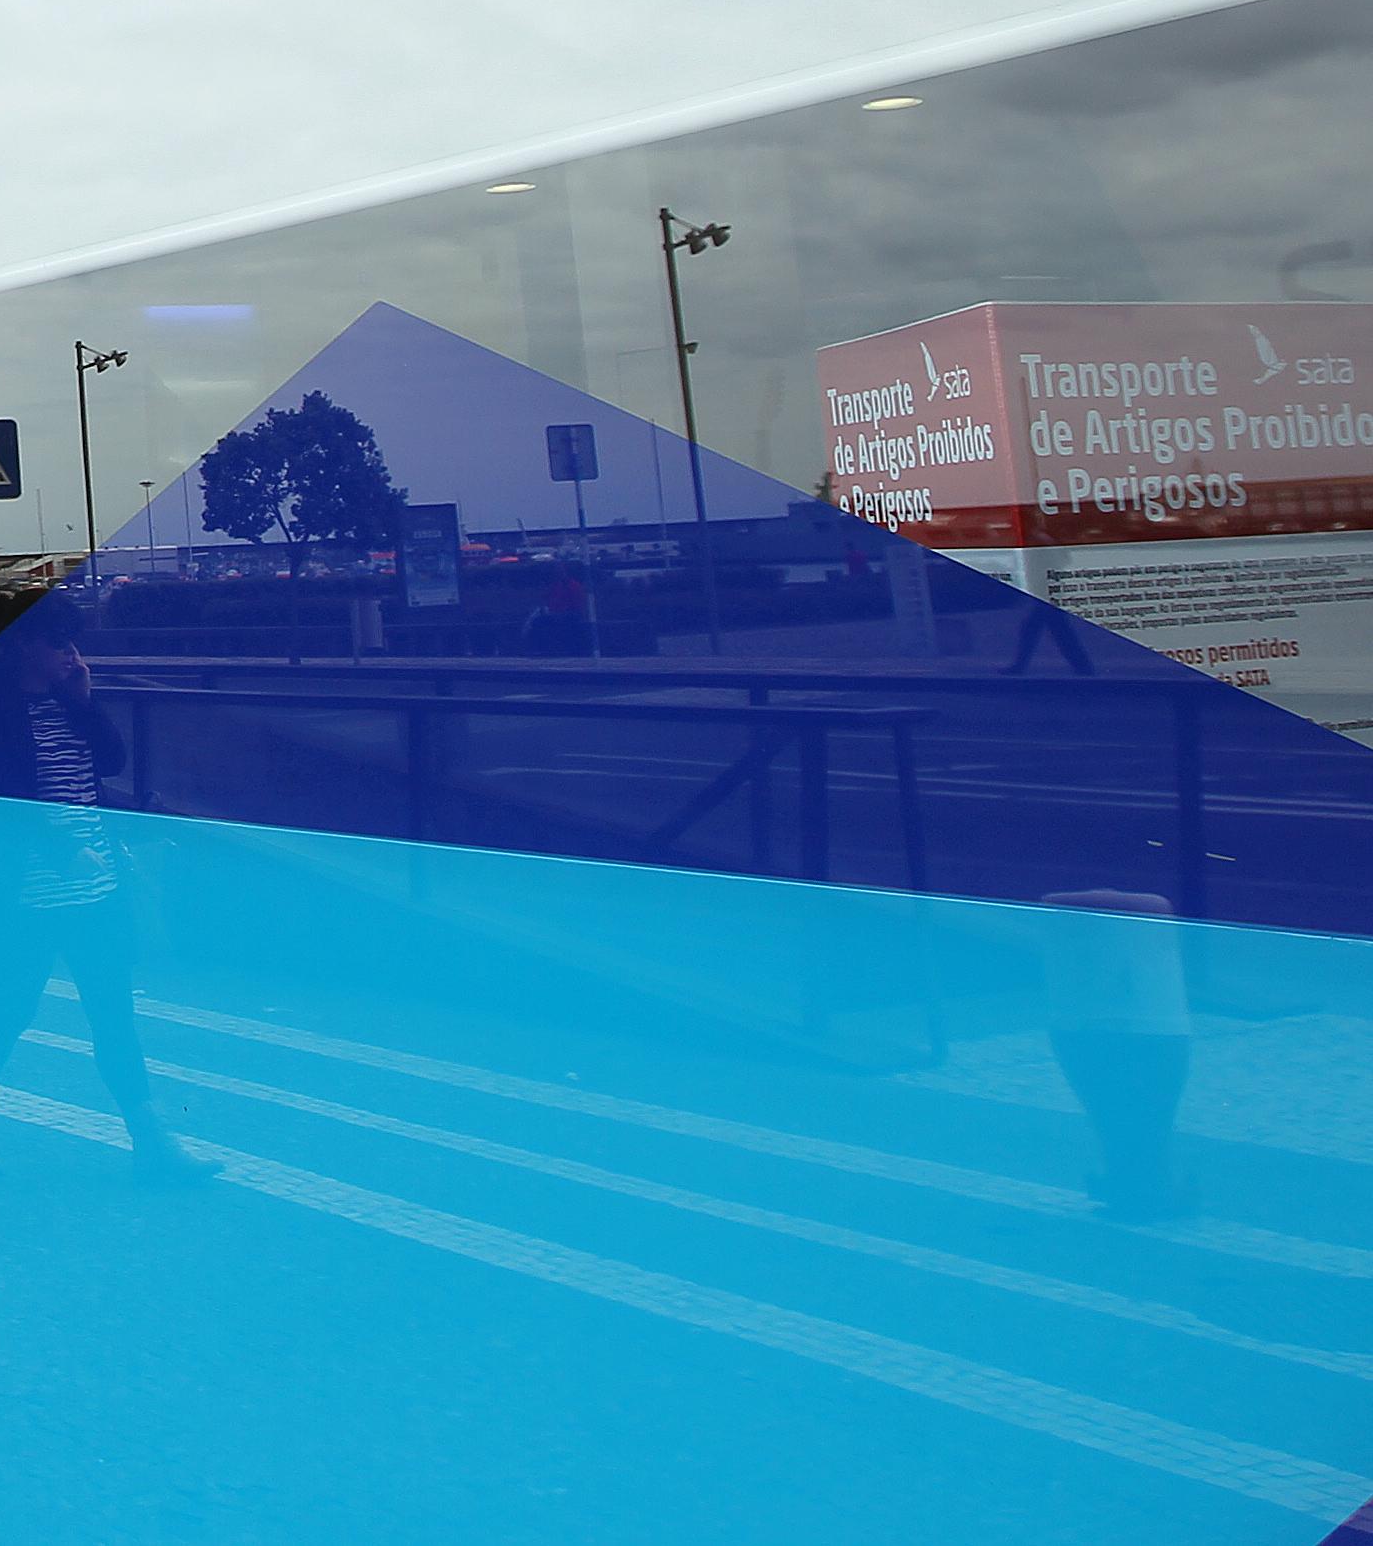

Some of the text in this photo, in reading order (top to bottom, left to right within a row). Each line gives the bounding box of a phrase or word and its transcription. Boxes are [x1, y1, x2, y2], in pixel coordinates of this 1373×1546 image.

[943, 365, 971, 400] sata
[1020, 354, 1218, 407] Transporte
[1295, 353, 1354, 385] sata
[827, 379, 914, 430] Transporte
[834, 416, 995, 481] de Artigos Proibidos
[1030, 410, 1074, 456] de
[1085, 408, 1215, 464] Artigos
[852, 482, 933, 533] Perigosos
[1037, 465, 1248, 522] e Perigosos
[1208, 637, 1300, 667] permitidos
[1236, 668, 1271, 687] SATA
